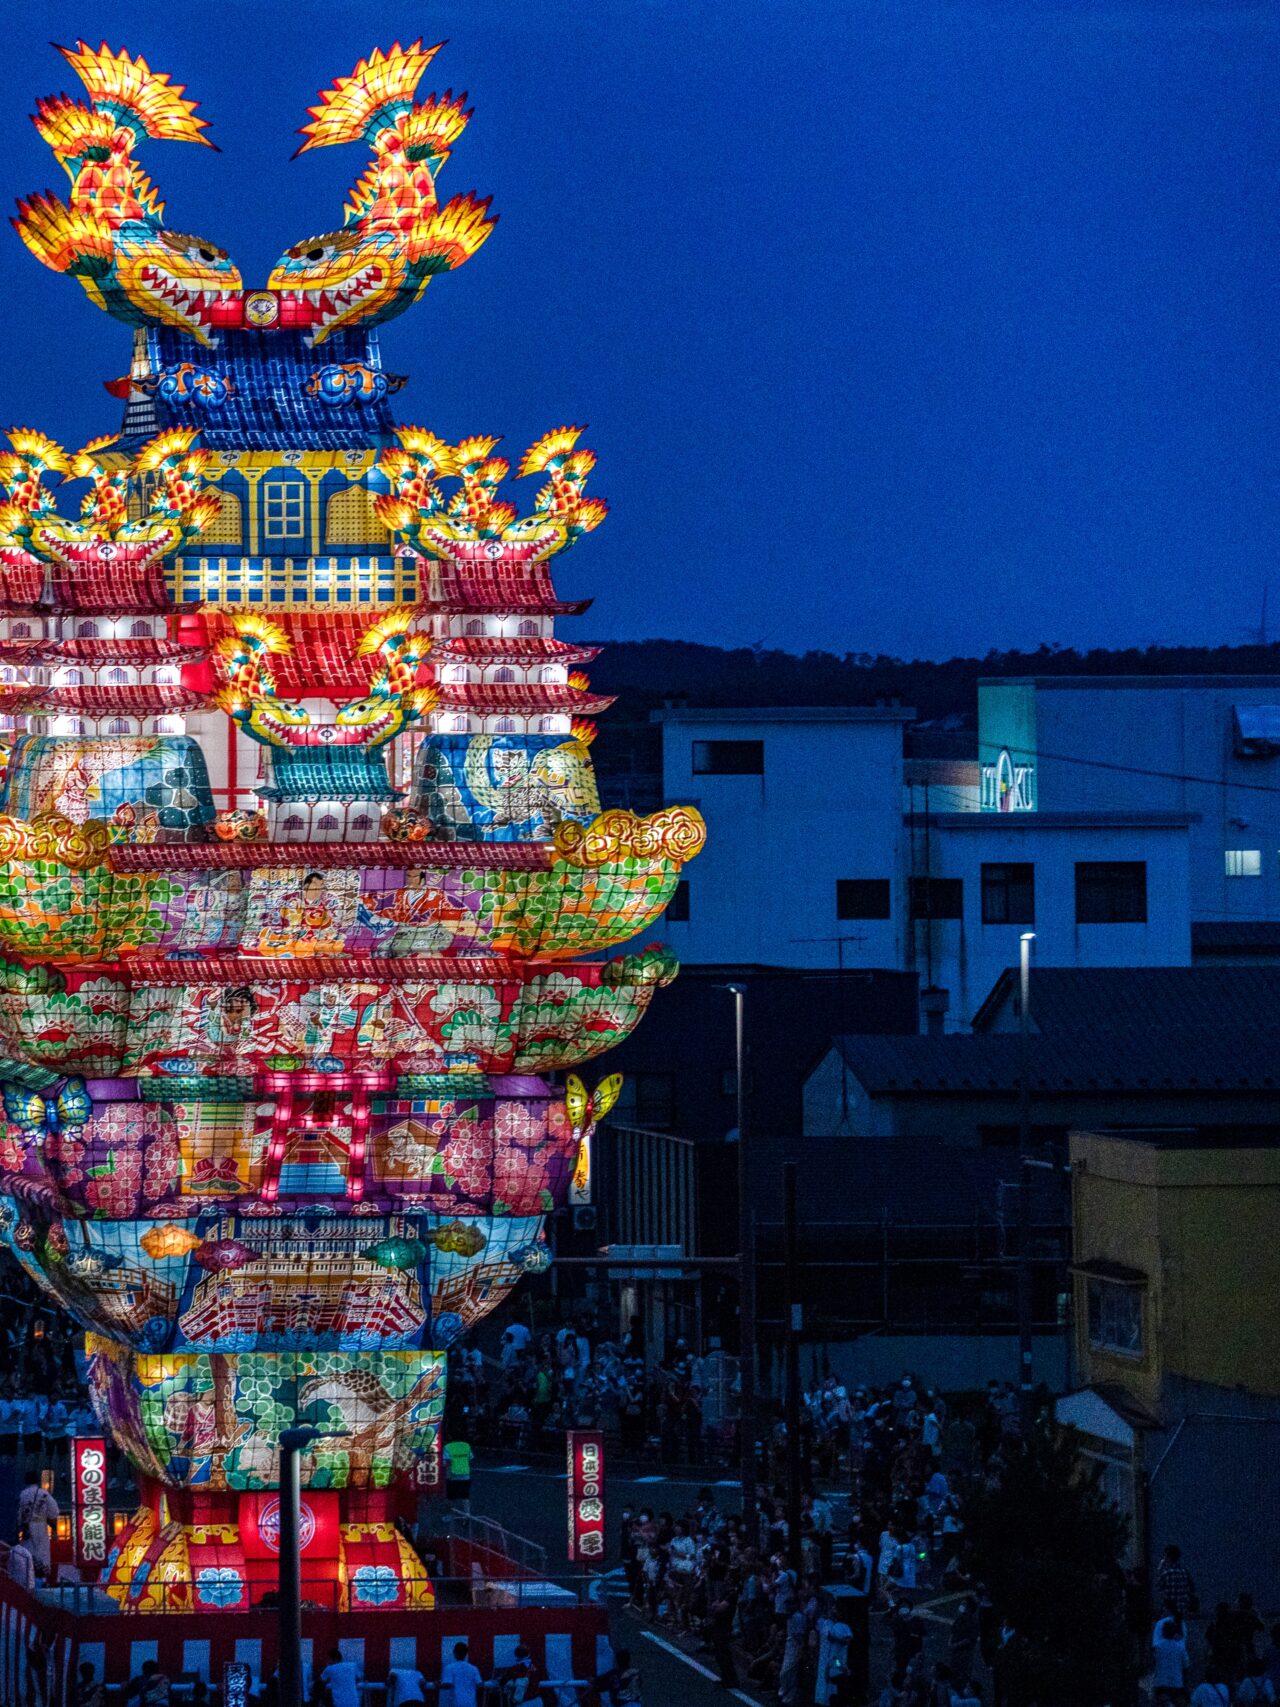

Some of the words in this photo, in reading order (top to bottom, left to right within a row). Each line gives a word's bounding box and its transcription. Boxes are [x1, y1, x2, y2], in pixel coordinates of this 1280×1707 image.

[81, 1448, 105, 1560] わのまち能代
